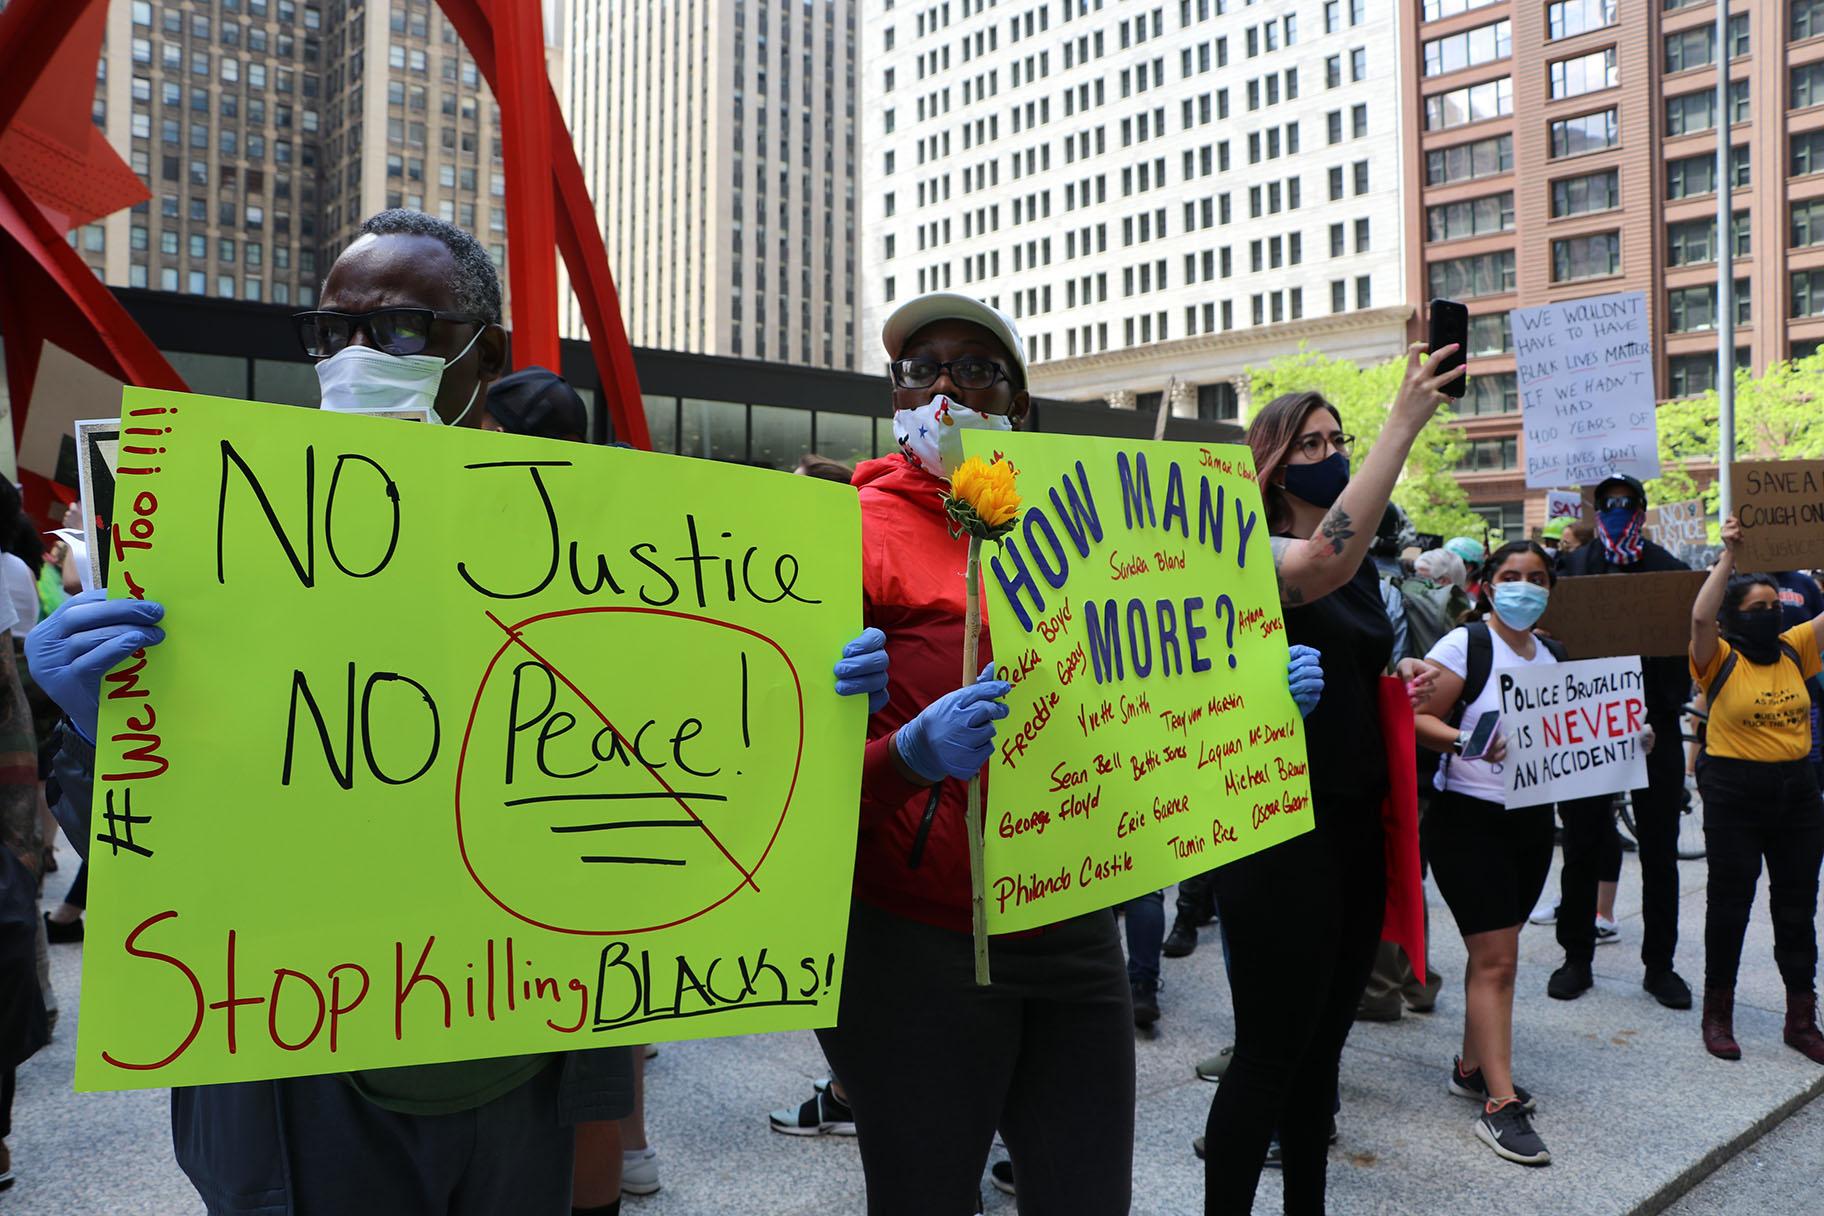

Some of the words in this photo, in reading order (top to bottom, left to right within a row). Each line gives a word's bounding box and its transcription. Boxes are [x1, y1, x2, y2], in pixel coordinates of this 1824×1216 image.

[1517, 334, 1557, 357] HAVE
[1565, 326, 1584, 341] TO
[1593, 318, 1638, 338] HAVE
[1520, 310, 1552, 331] WE
[1519, 359, 1559, 385] BLACK
[1565, 350, 1599, 370] LIVES
[1604, 342, 1650, 363] MATTER
[1523, 388, 1544, 410] IF
[1555, 382, 1577, 400] WE
[1554, 400, 1593, 418] HAD
[1529, 427, 1558, 445] 400
[1568, 417, 1616, 436] YEARS
[1629, 411, 1650, 427] OF
[1528, 457, 1560, 476] BLACK
[1566, 449, 1595, 466] LIVES
[1565, 463, 1617, 480] MATTER
[1746, 470, 1799, 496] SAVE
[1803, 471, 1818, 493] A
[217, 439, 400, 589] NO
[458, 461, 822, 608] Justice
[1553, 500, 1582, 517] SAY
[1659, 503, 1685, 525] NO
[1739, 503, 1797, 529] COUGH
[990, 460, 1104, 633] HOW
[1116, 451, 1256, 568] MANY
[1154, 549, 1185, 572] Bland
[1036, 596, 1072, 643] Boyd
[1084, 594, 1238, 685] MORE?
[1119, 691, 1151, 724] Smith
[1500, 674, 1559, 714] POLICE
[1565, 671, 1643, 702] BRUTALITY
[282, 661, 441, 790] NO
[505, 651, 751, 784] Peace!
[1517, 725, 1533, 749] IS
[1542, 698, 1642, 748] NEVER
[1163, 745, 1187, 763] Jones
[1198, 738, 1243, 771] Laquan
[1513, 760, 1538, 791] AN
[1543, 738, 1635, 783] ACCIDENT!
[1049, 761, 1088, 793] Sean
[1093, 752, 1121, 775] Bell
[1058, 785, 1101, 821] Floyd
[1167, 836, 1205, 859] Tamir
[1212, 818, 1239, 849] Rice
[993, 866, 1071, 914] Philando
[1079, 851, 1133, 888] Castile
[395, 935, 588, 1041] Killing
